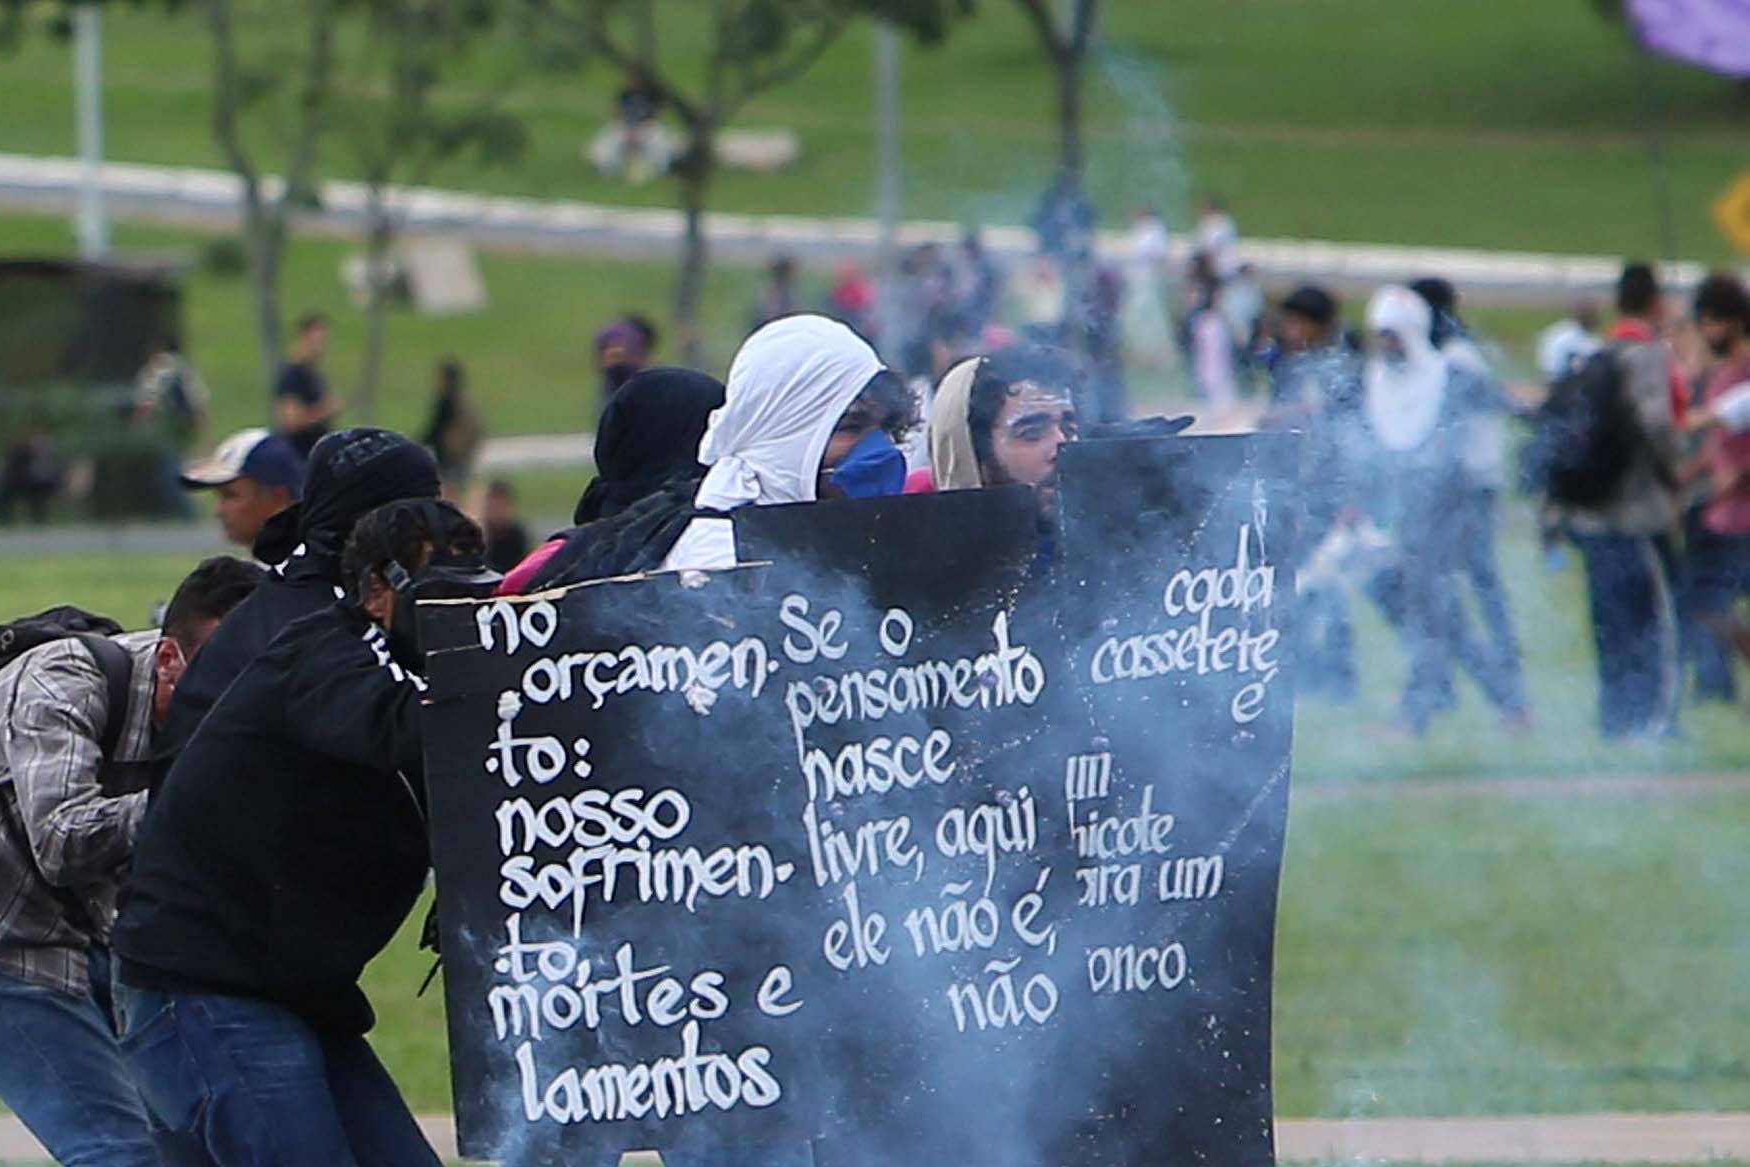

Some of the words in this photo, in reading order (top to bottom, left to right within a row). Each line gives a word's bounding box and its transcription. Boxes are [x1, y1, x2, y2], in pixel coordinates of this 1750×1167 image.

[1163, 524, 1275, 614] cada
[475, 600, 558, 654] no
[779, 593, 848, 663] Se
[879, 608, 914, 656] o
[1091, 602, 1279, 684] cassetete
[785, 610, 1045, 758] pensamento
[1231, 668, 1279, 724] é
[802, 729, 955, 801] nasce
[495, 788, 690, 856] nosso
[803, 801, 924, 887] livre,
[935, 786, 1038, 897] aqui
[1068, 784, 1175, 858] hicote
[1075, 863, 1142, 907] ara
[1158, 855, 1224, 902] um
[823, 881, 891, 970] ele
[903, 880, 999, 957] não
[488, 942, 728, 1040] mortes
[757, 966, 804, 1015] e
[947, 956, 1059, 1032] não
[1087, 942, 1186, 992] onco
[515, 1019, 781, 1123] lamentos
